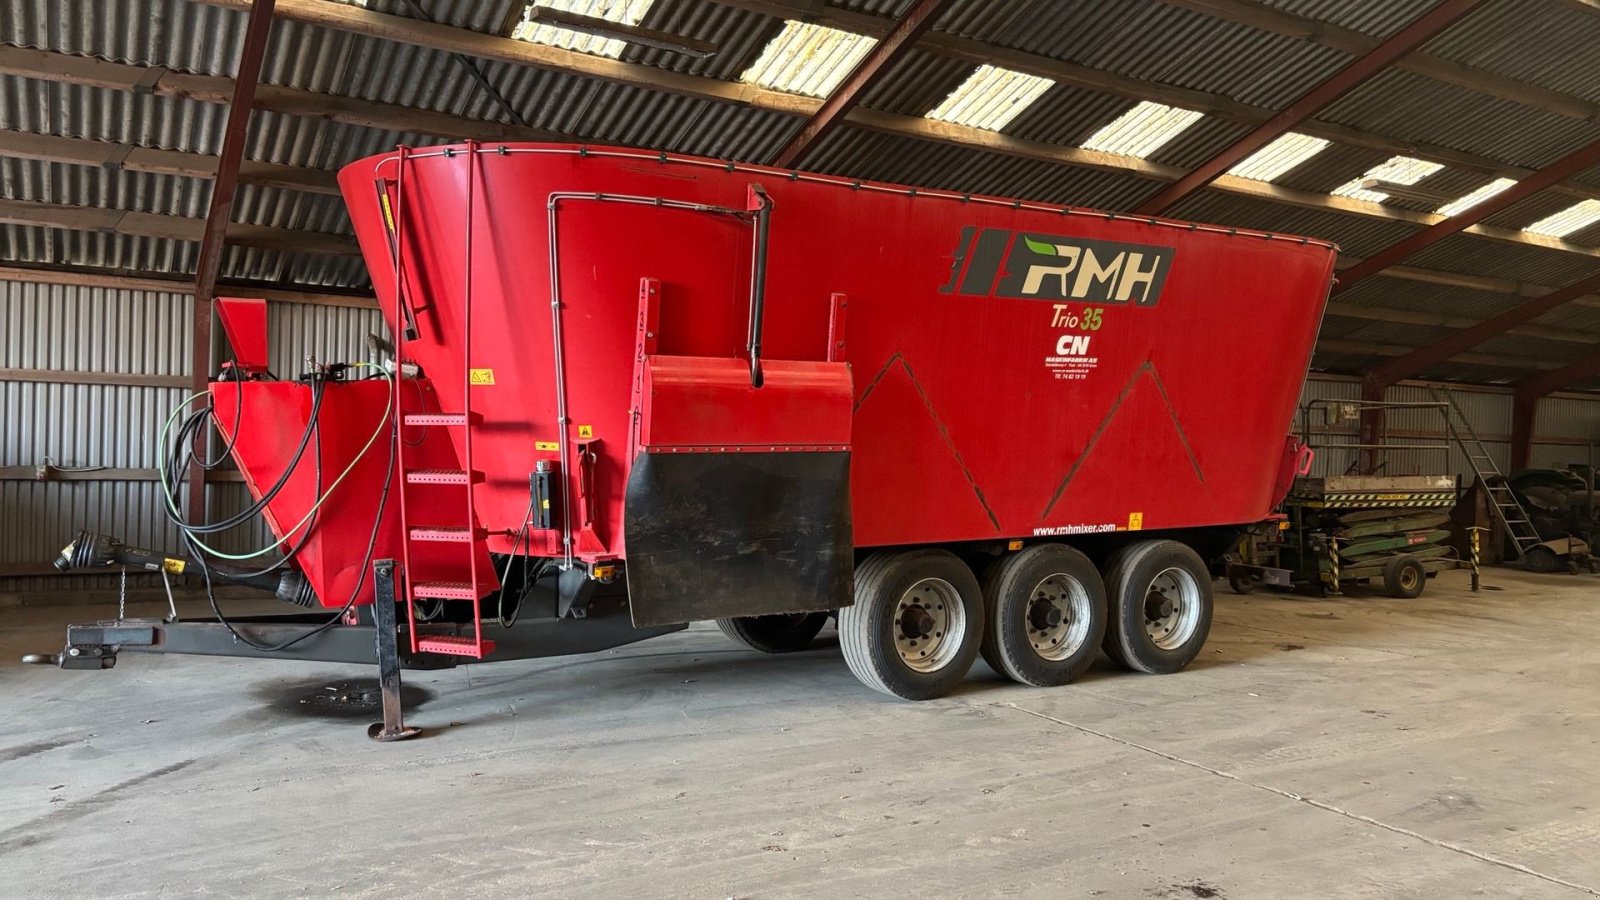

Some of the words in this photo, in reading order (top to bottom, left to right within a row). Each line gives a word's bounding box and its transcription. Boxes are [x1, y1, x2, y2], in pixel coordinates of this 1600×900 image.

[1021, 236, 1160, 302] RMH
[1050, 304, 1079, 328] Trio
[1080, 307, 1104, 331] 35
[1056, 335, 1091, 355] CN
[1033, 523, 1116, 536] www.rmhmixer.com
